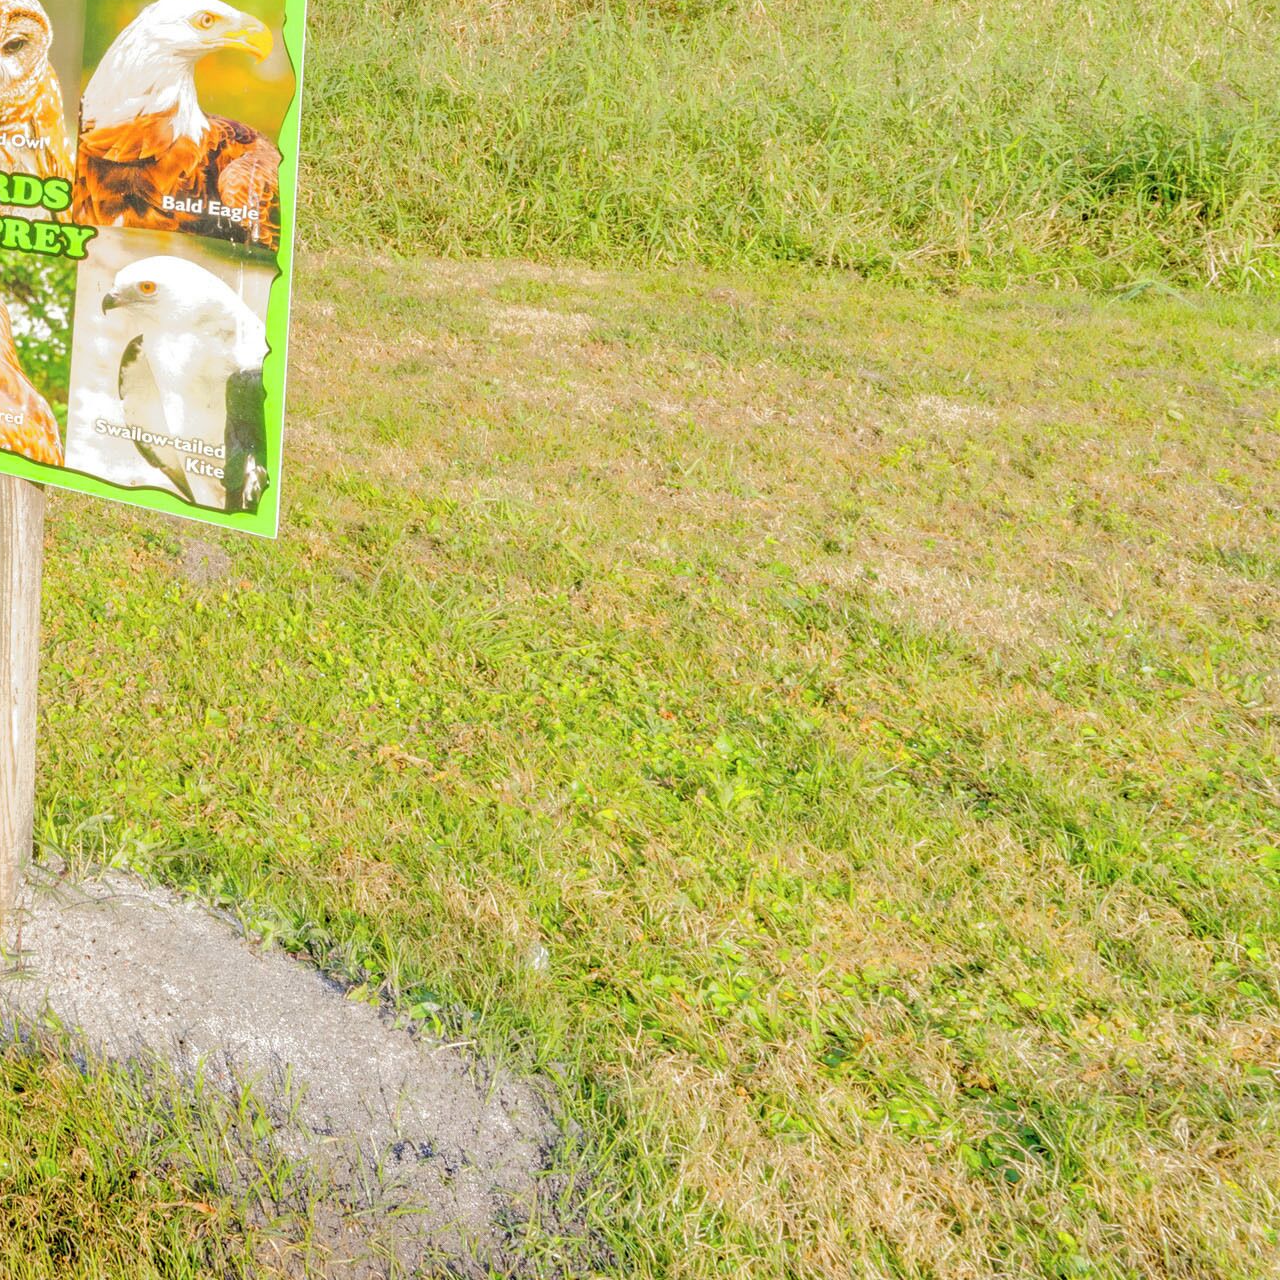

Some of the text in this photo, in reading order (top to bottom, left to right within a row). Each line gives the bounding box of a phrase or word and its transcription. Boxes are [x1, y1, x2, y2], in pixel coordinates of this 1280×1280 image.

[11, 134, 44, 150] Owl
[162, 195, 259, 222] Bald Eagle
[185, 457, 225, 479] Kite
